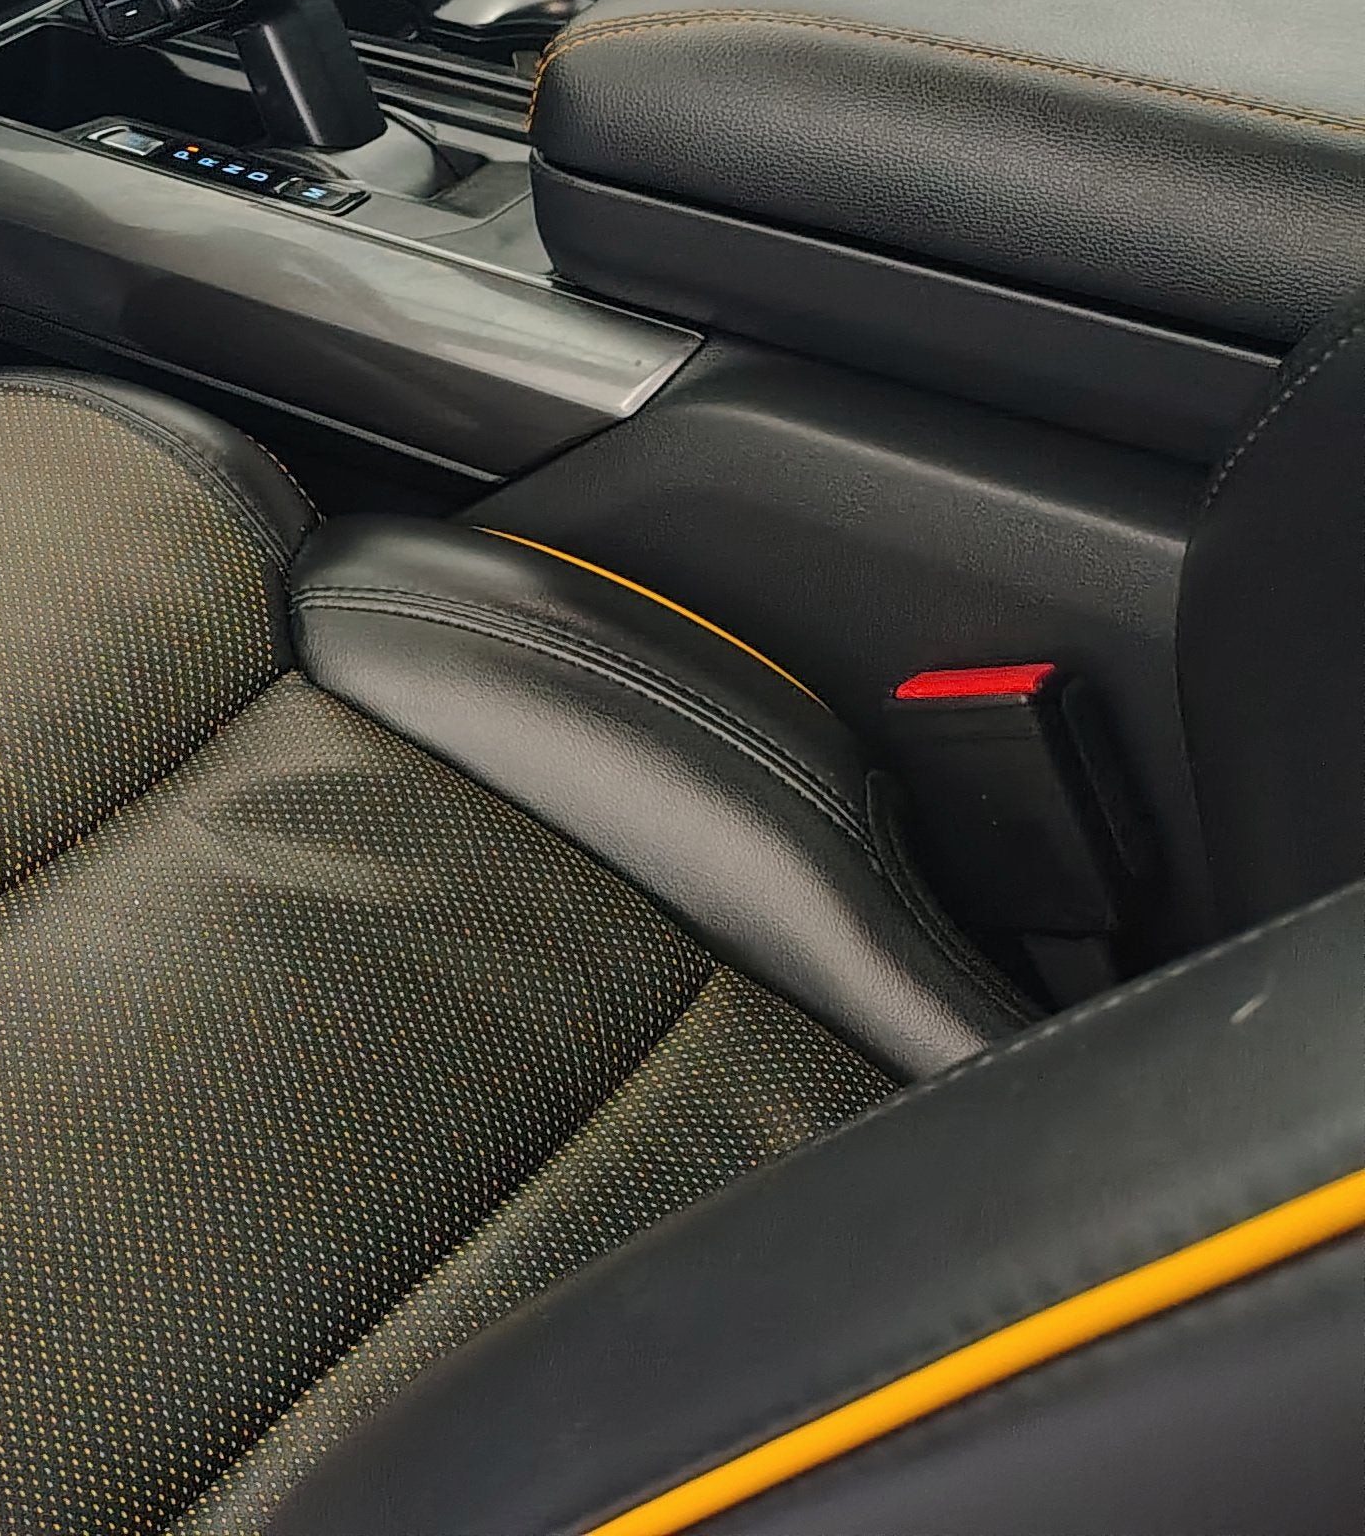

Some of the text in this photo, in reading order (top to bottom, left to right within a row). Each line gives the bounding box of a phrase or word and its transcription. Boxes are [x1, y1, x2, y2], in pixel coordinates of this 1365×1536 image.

[172, 150, 270, 182] P R N D
